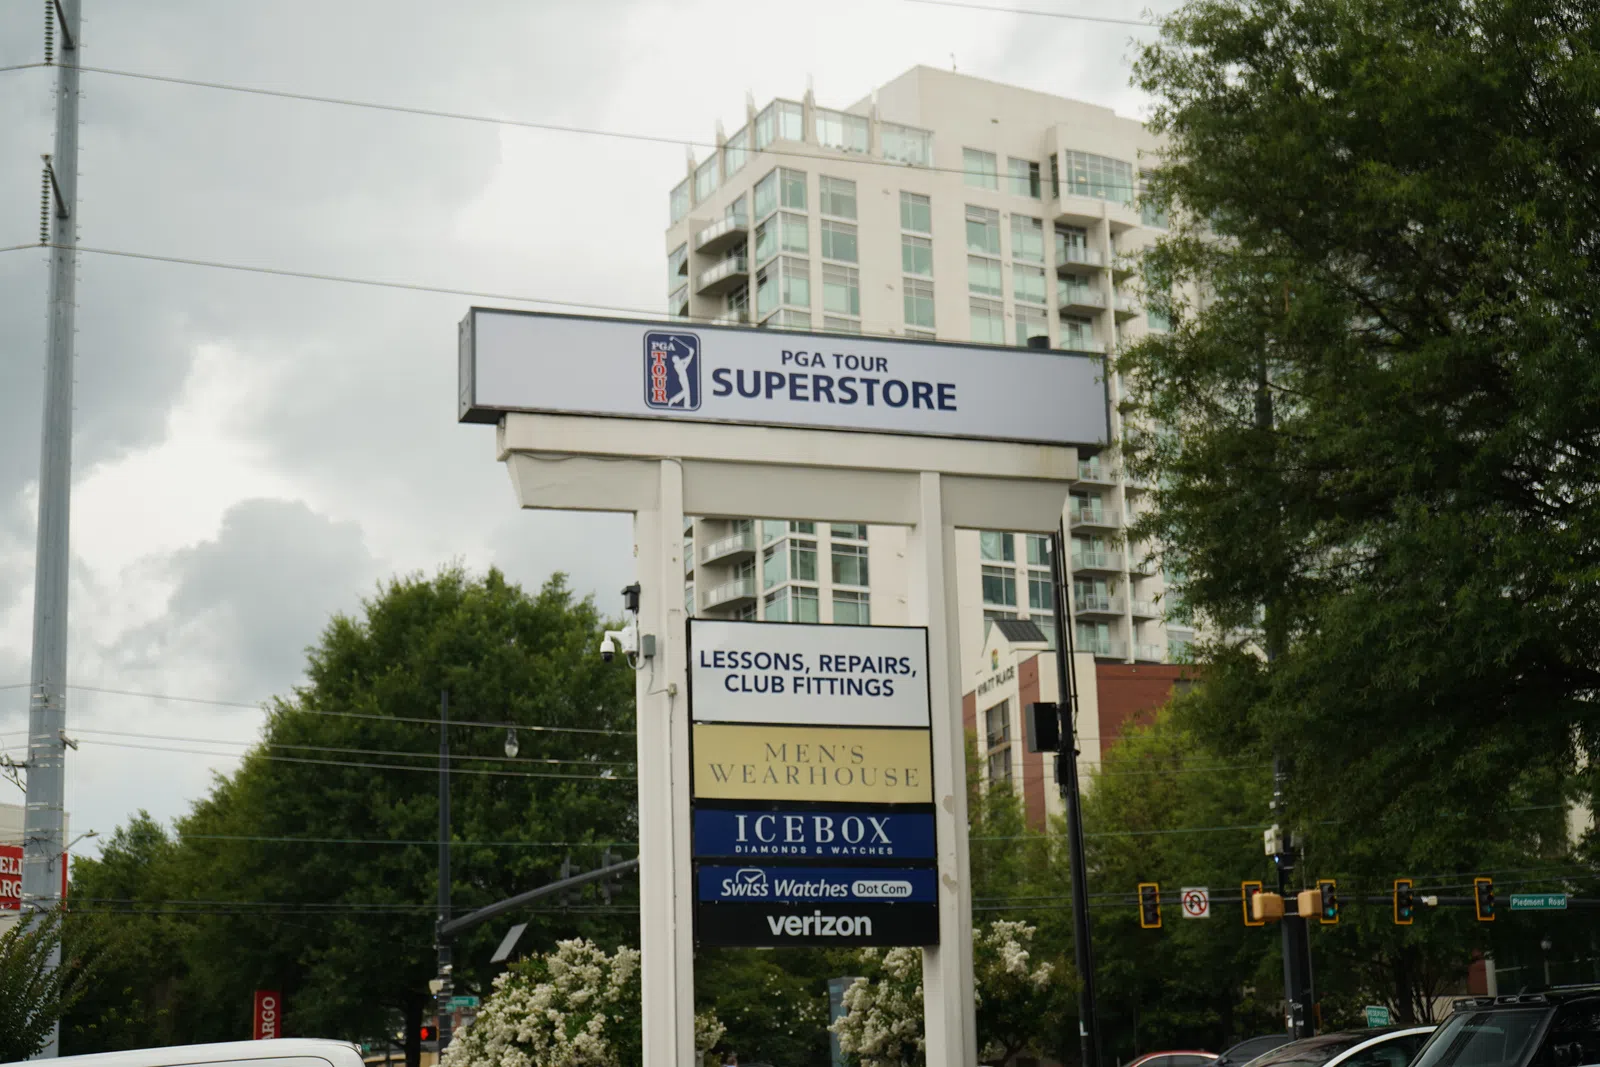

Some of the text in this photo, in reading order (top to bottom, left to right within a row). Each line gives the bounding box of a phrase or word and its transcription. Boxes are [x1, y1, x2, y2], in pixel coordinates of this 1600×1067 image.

[651, 341, 676, 351] PGA
[781, 350, 888, 373] PGA TOUR
[651, 351, 668, 403] TOUR
[711, 367, 957, 411] SUPERSTORE
[700, 650, 917, 678] LESSONS, REPAIRS,
[724, 674, 894, 697] CLUB FITTINGS
[765, 742, 865, 765] MEN'S
[709, 763, 919, 787] WEARHOUSE
[735, 814, 892, 844] ICEBOX
[735, 845, 807, 854] DIAMONDS
[831, 846, 893, 855] WATCHES
[720, 873, 907, 898] Swiss Watches Dot Com
[1512, 896, 1565, 907] Piedmont Road
[767, 910, 872, 936] verizon
[261, 996, 276, 1040] ARGO
